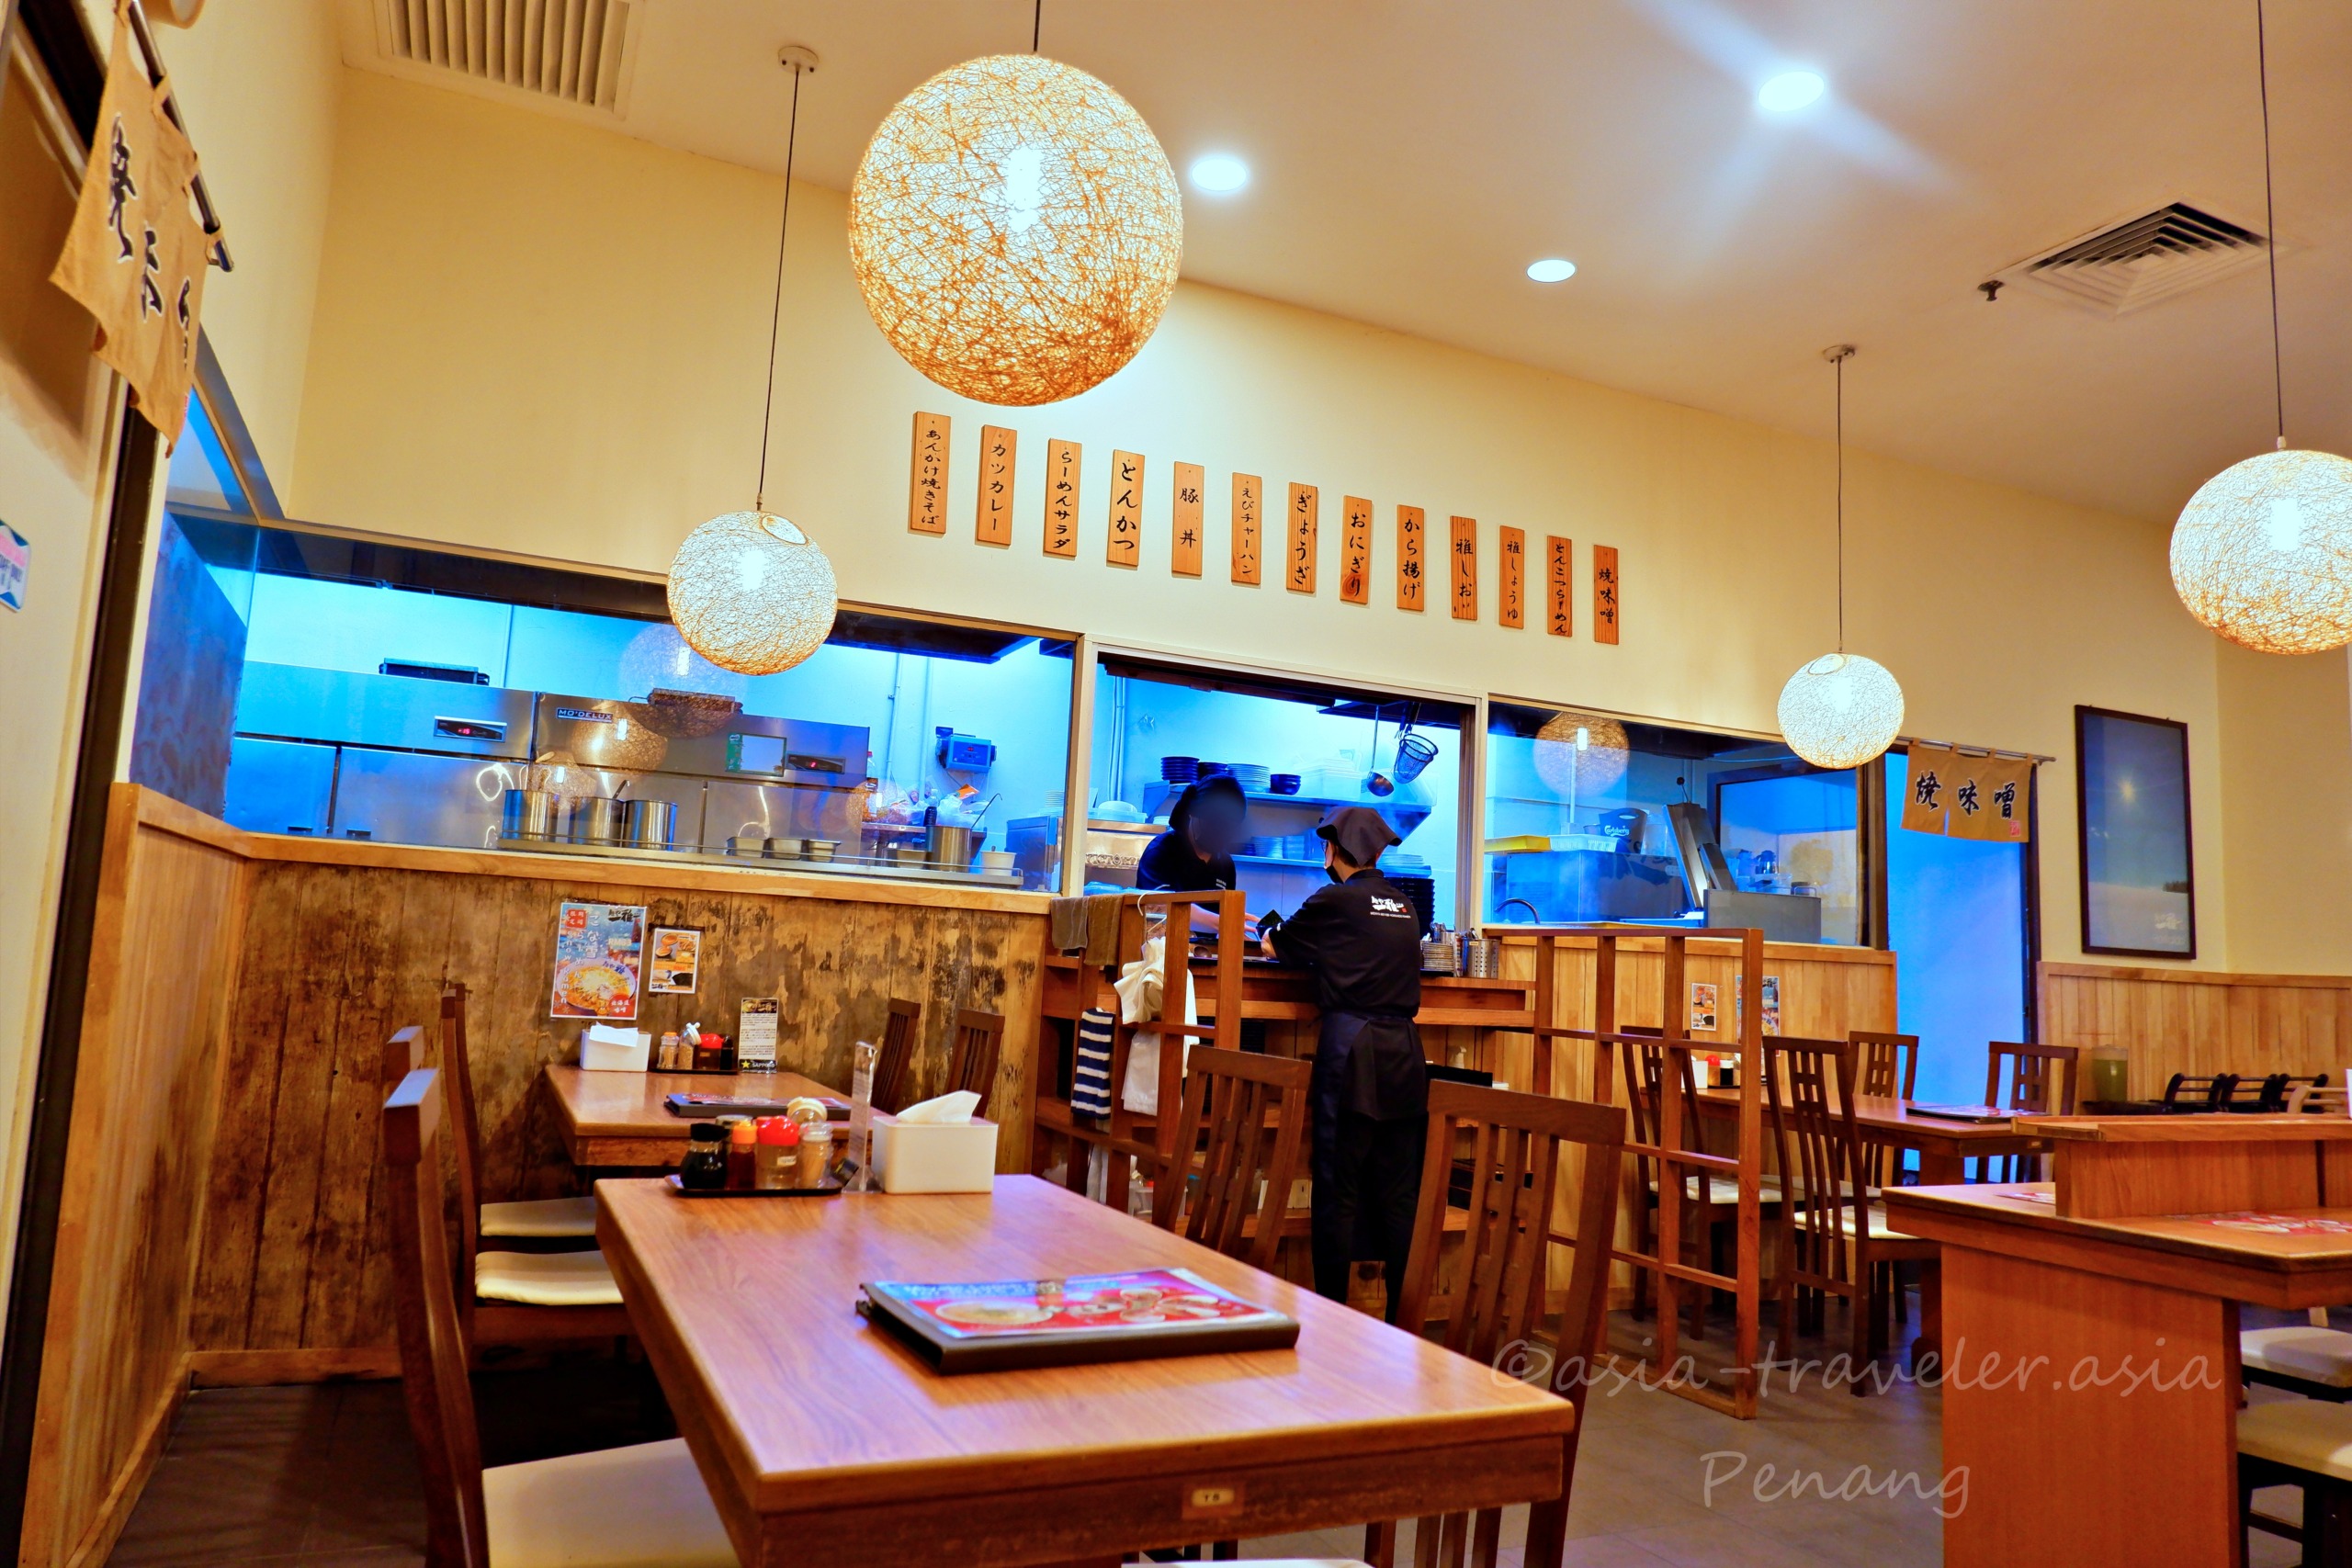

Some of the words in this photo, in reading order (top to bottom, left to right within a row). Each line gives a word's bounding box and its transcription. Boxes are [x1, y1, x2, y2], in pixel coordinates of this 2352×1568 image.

[922, 429, 941, 525] あんかけ焼きそば
[989, 444, 1007, 531] カツカレー
[1055, 450, 1072, 549] らーめんサラダ
[1114, 462, 1137, 551] とんかつ
[1181, 487, 1199, 549] 豚丼
[1240, 486, 1256, 576] えびチャーハン
[1295, 494, 1311, 585] ぎょうざ
[1350, 513, 1366, 598] おにぎり
[1403, 517, 1420, 600] から揚げ
[1456, 538, 1473, 597] 雅しお
[1507, 541, 1521, 619] 雅しょうゆ
[1554, 543, 1567, 633] とんこつらーめん
[1599, 567, 1615, 625] 焼味噌
[1604, 825, 1630, 837] Carlsberg
[1916, 770, 2016, 819] 焼味噌
